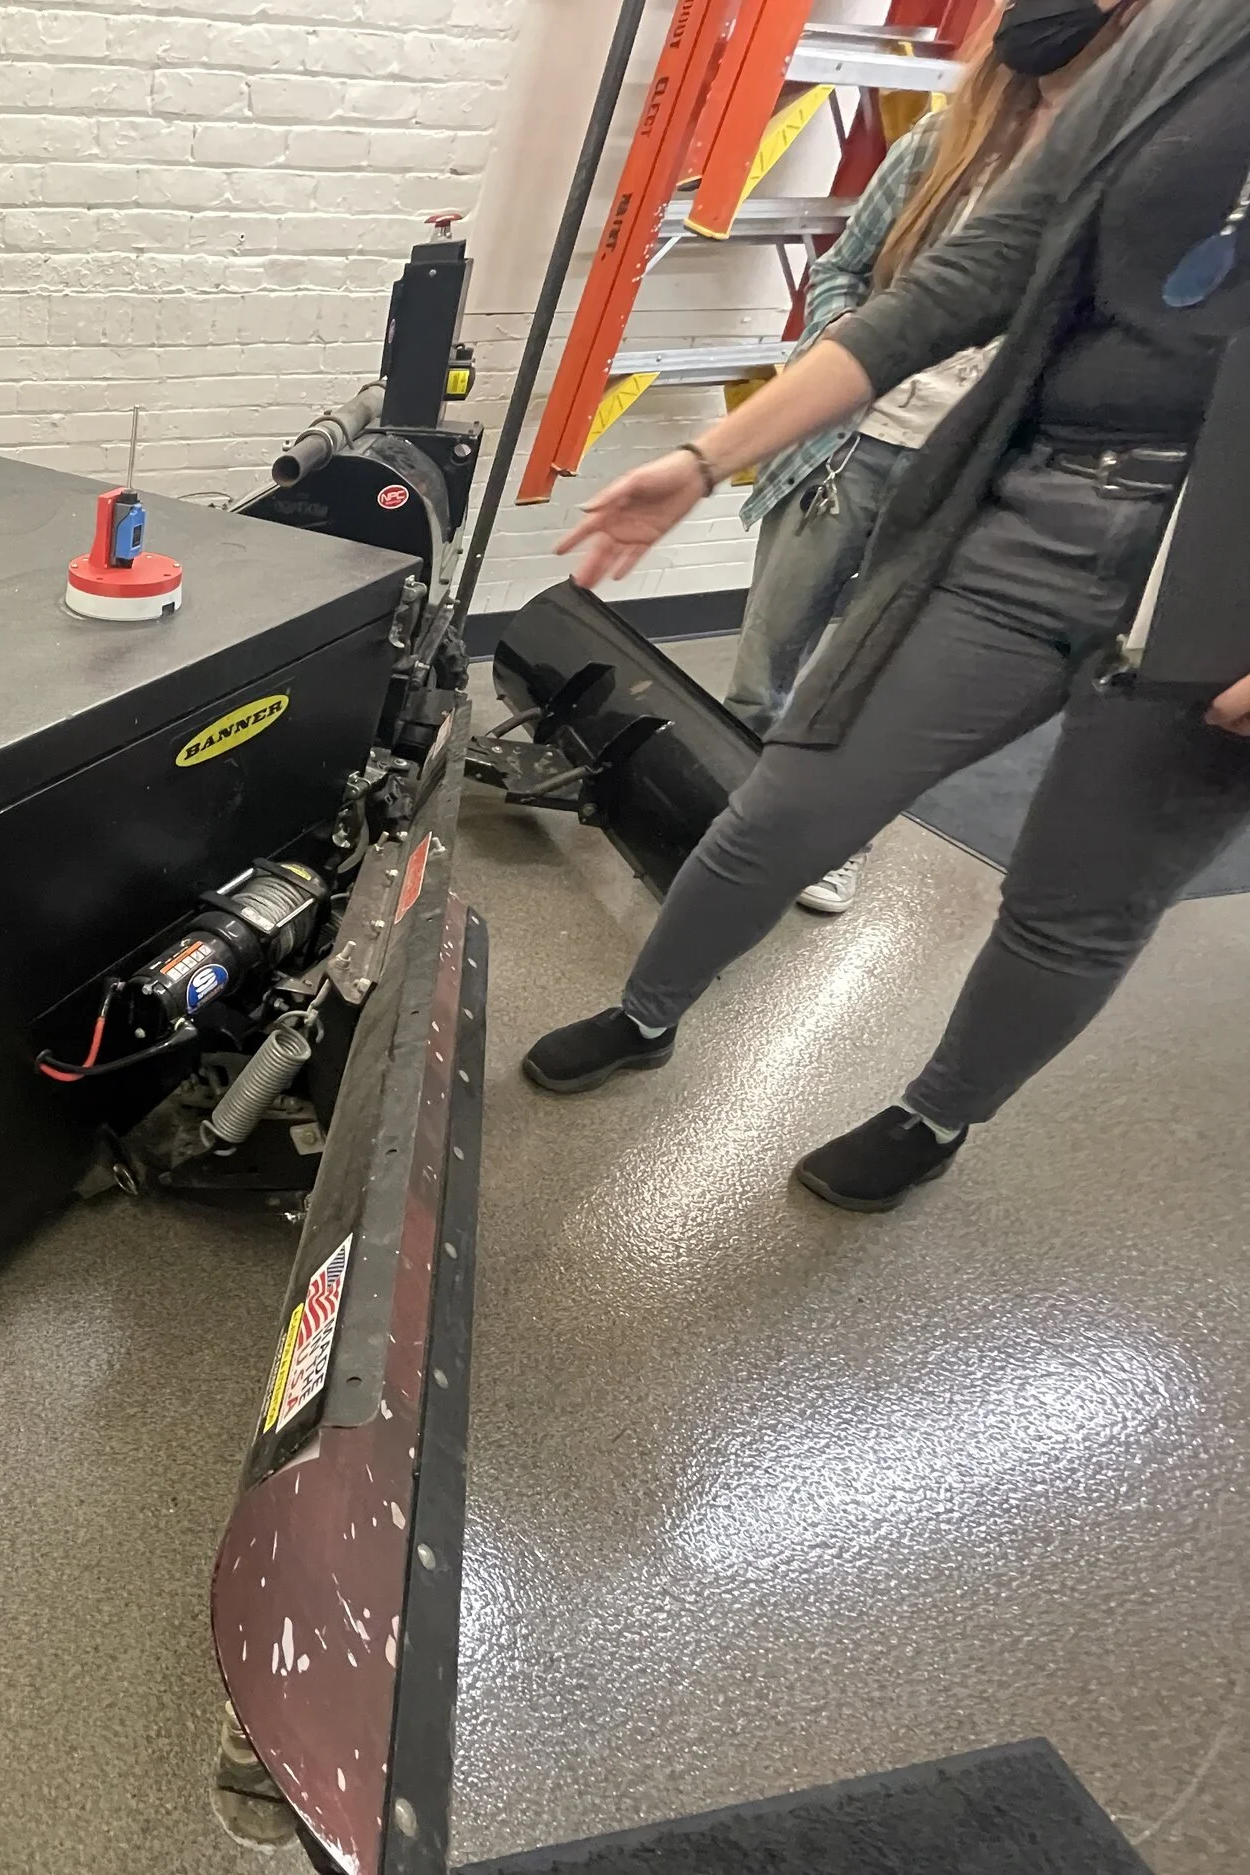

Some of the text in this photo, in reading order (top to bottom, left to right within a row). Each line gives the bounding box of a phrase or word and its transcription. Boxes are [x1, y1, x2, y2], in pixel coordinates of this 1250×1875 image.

[381, 490, 405, 503] NPC
[184, 700, 283, 761] BANNER
[298, 1328, 323, 1406] IN THE
[311, 1317, 335, 1392] MADE
